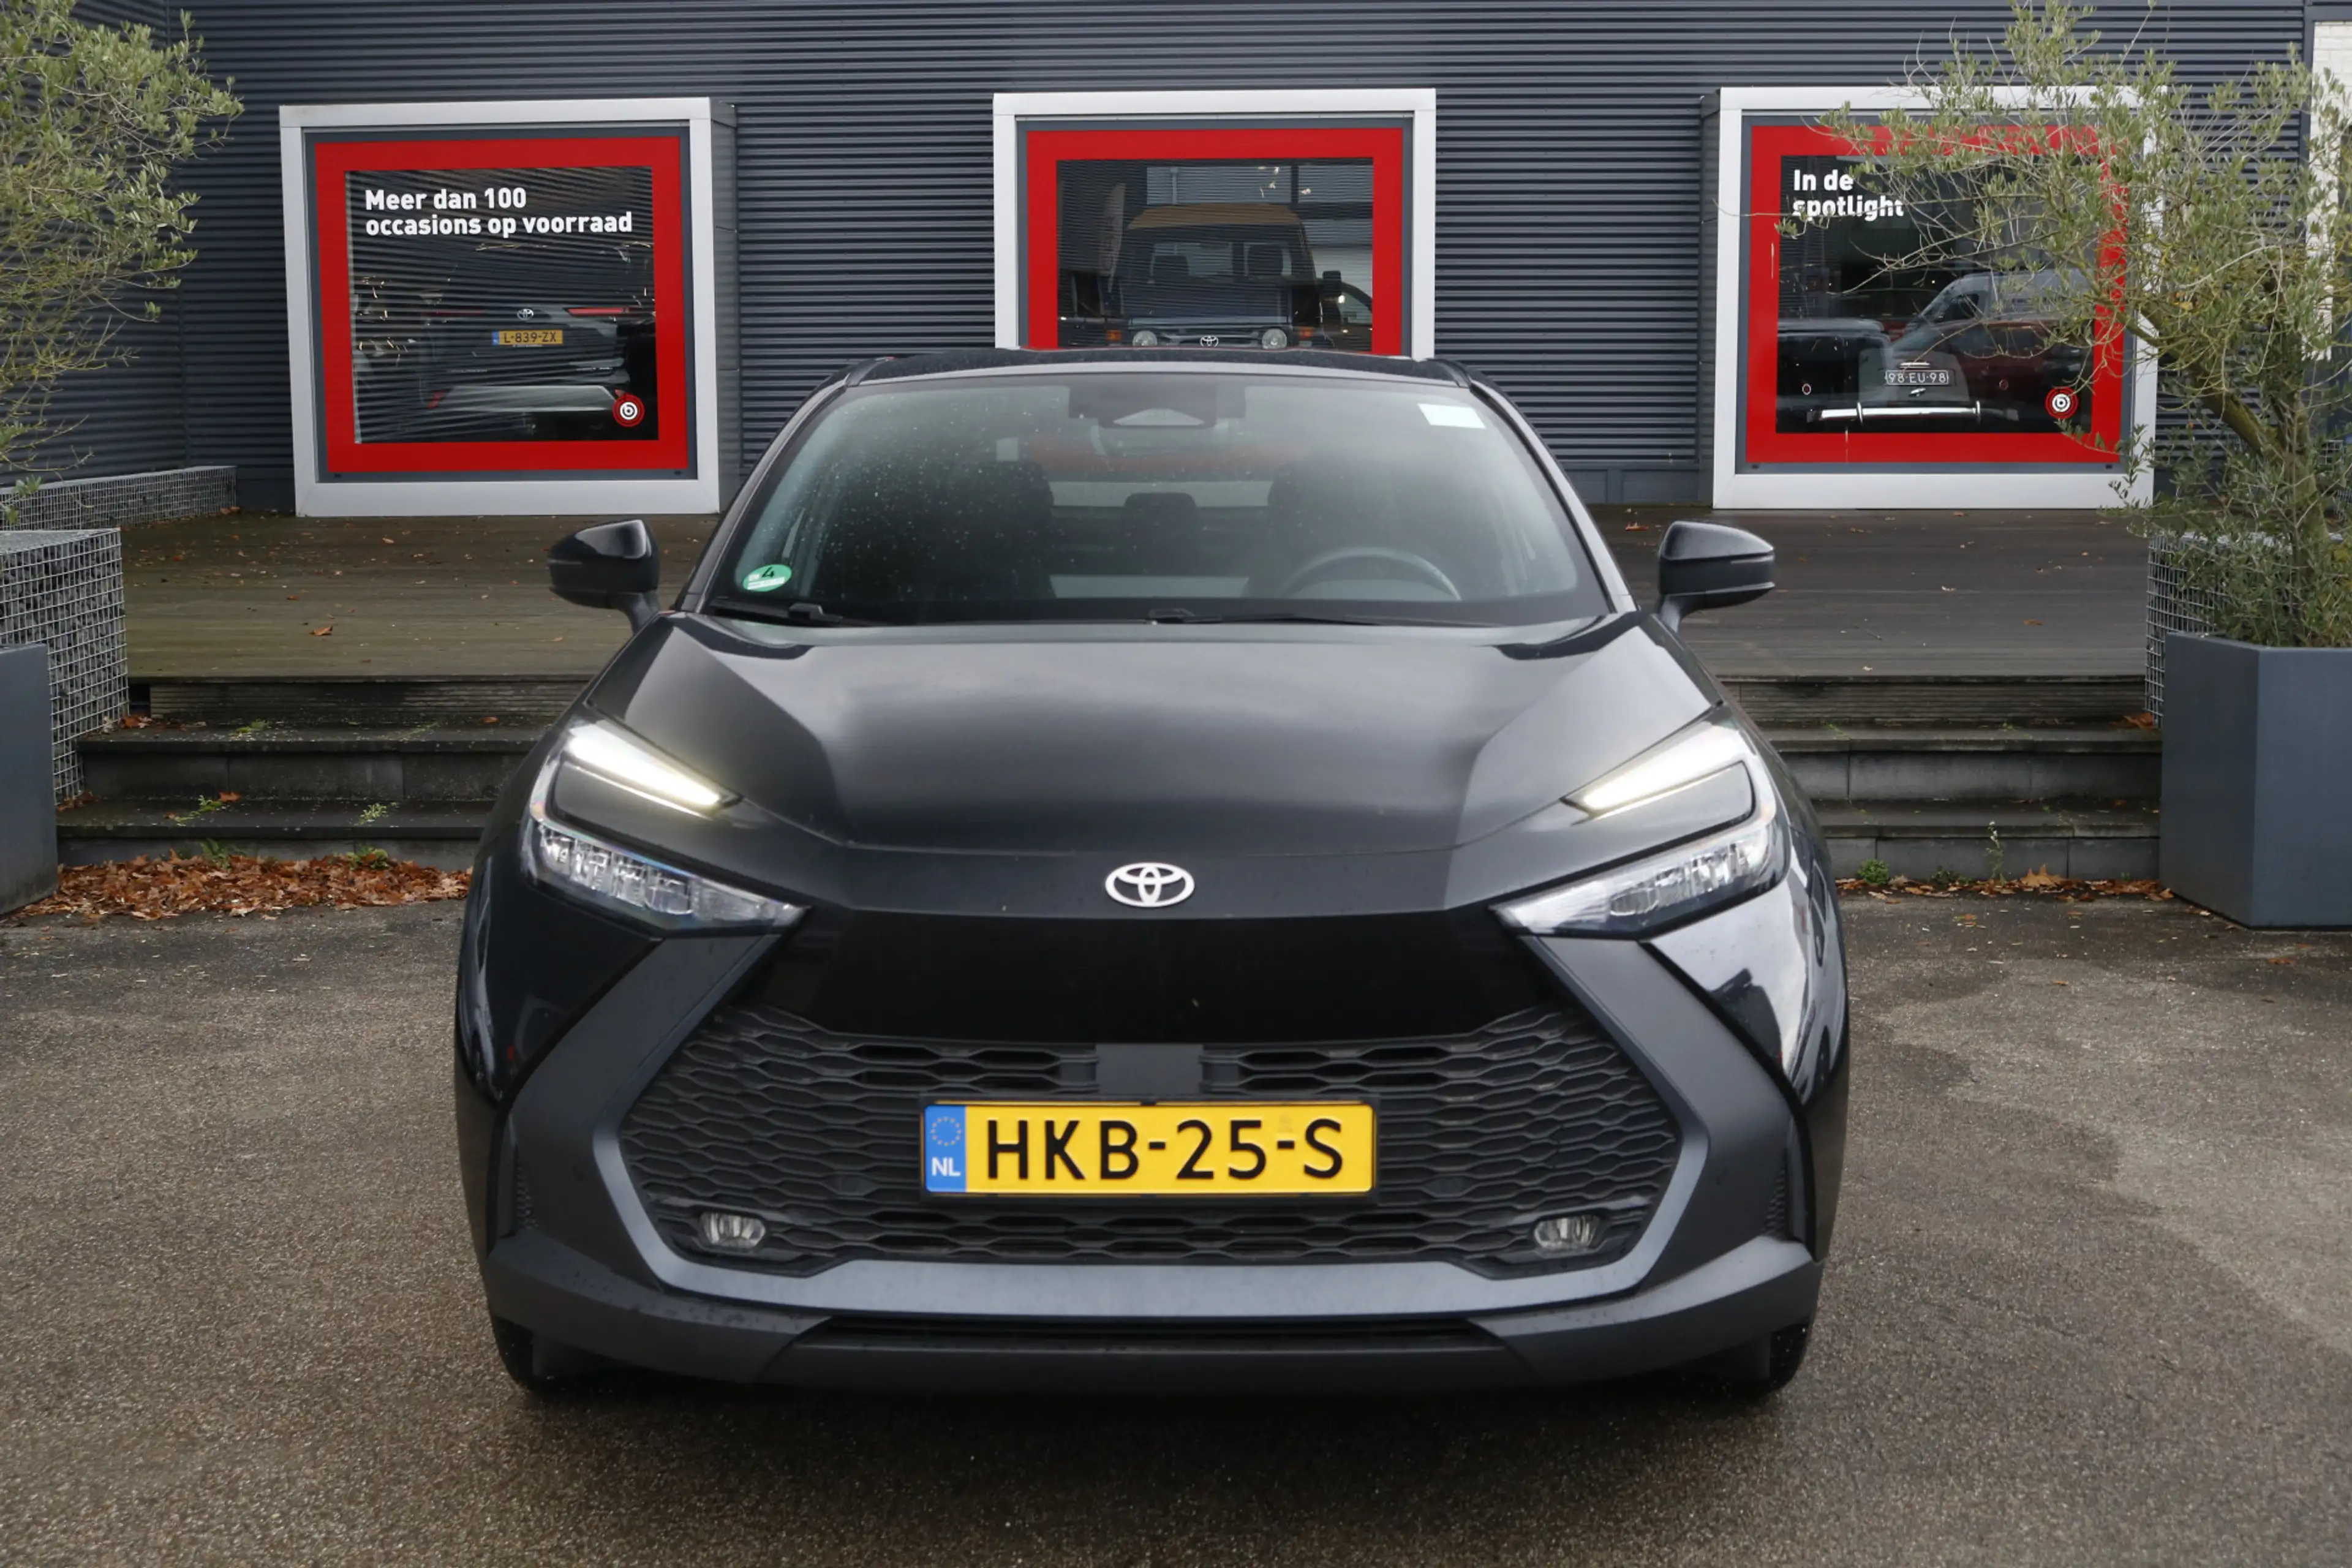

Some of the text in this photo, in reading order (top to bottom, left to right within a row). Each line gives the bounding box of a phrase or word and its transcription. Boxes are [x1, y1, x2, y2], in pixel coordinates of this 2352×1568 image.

[1793, 169, 1854, 191] In de
[365, 187, 526, 211] Meer dan 100
[1792, 195, 1904, 221] spotlight
[366, 211, 632, 238] occasions op voorraad
[987, 1118, 1343, 1180] HKB-25-S
[932, 1156, 961, 1177] NL
